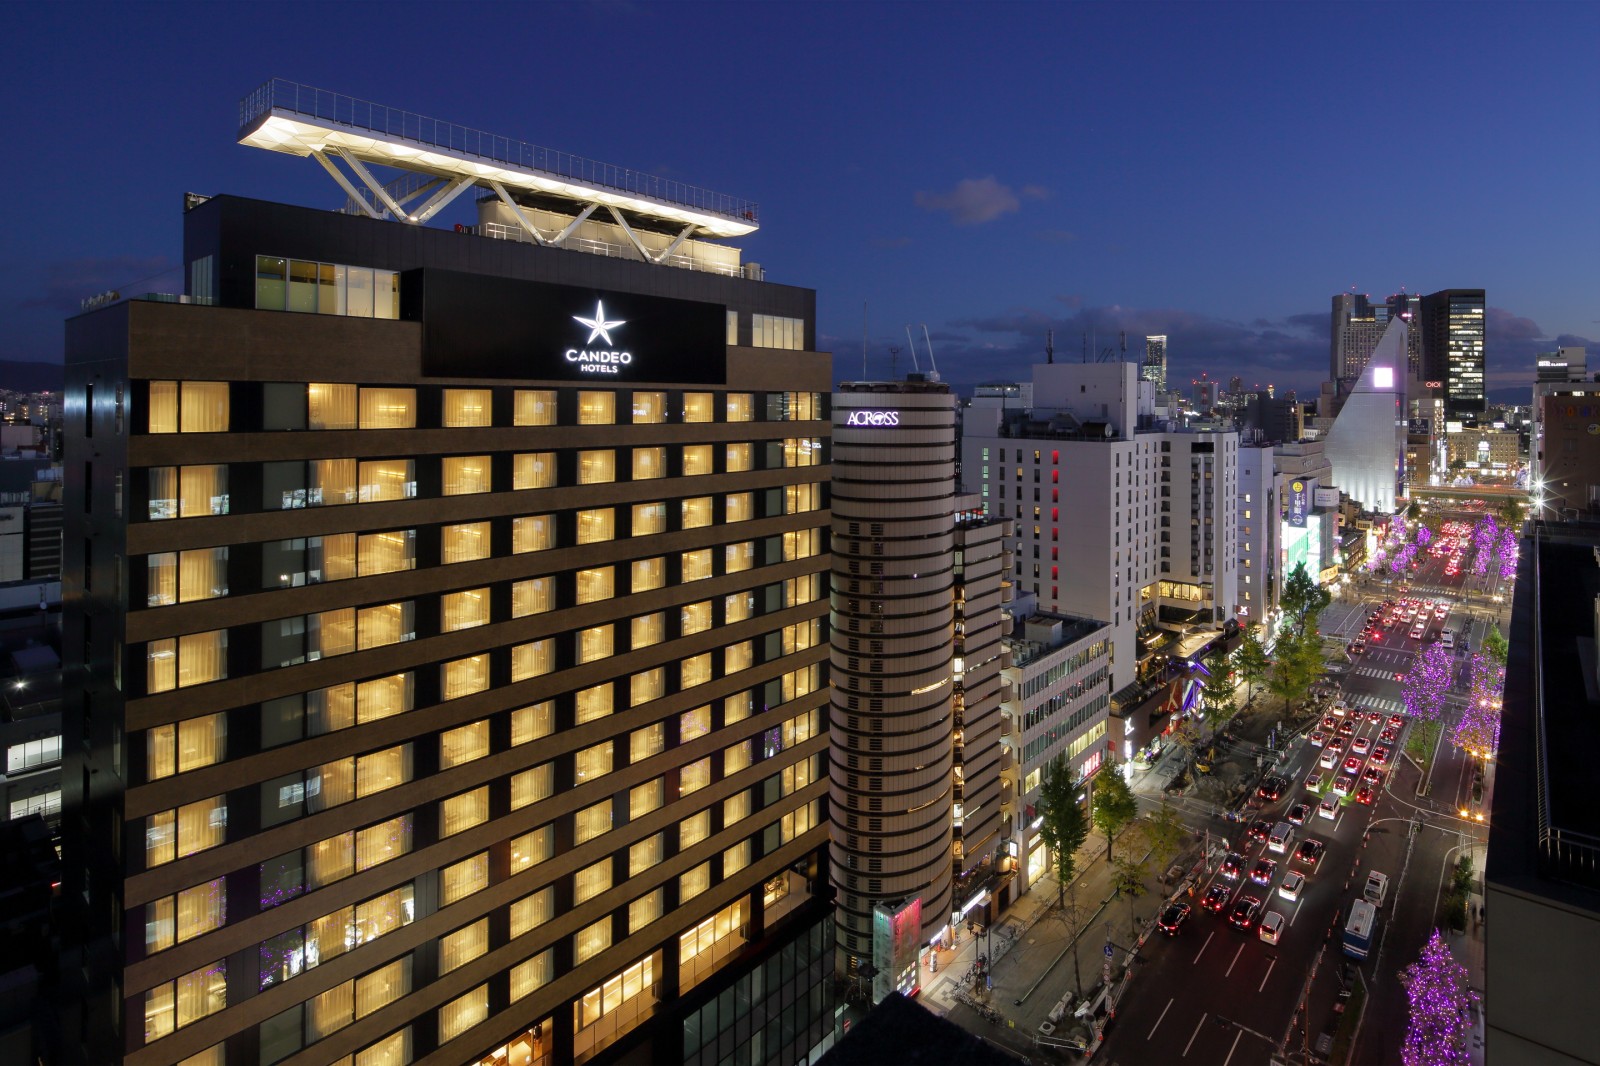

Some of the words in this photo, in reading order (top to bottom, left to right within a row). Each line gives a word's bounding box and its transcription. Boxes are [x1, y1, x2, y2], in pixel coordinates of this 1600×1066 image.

[566, 349, 632, 364] CANDEO
[581, 364, 618, 374] HOTELS
[847, 411, 899, 426] ACROSS
